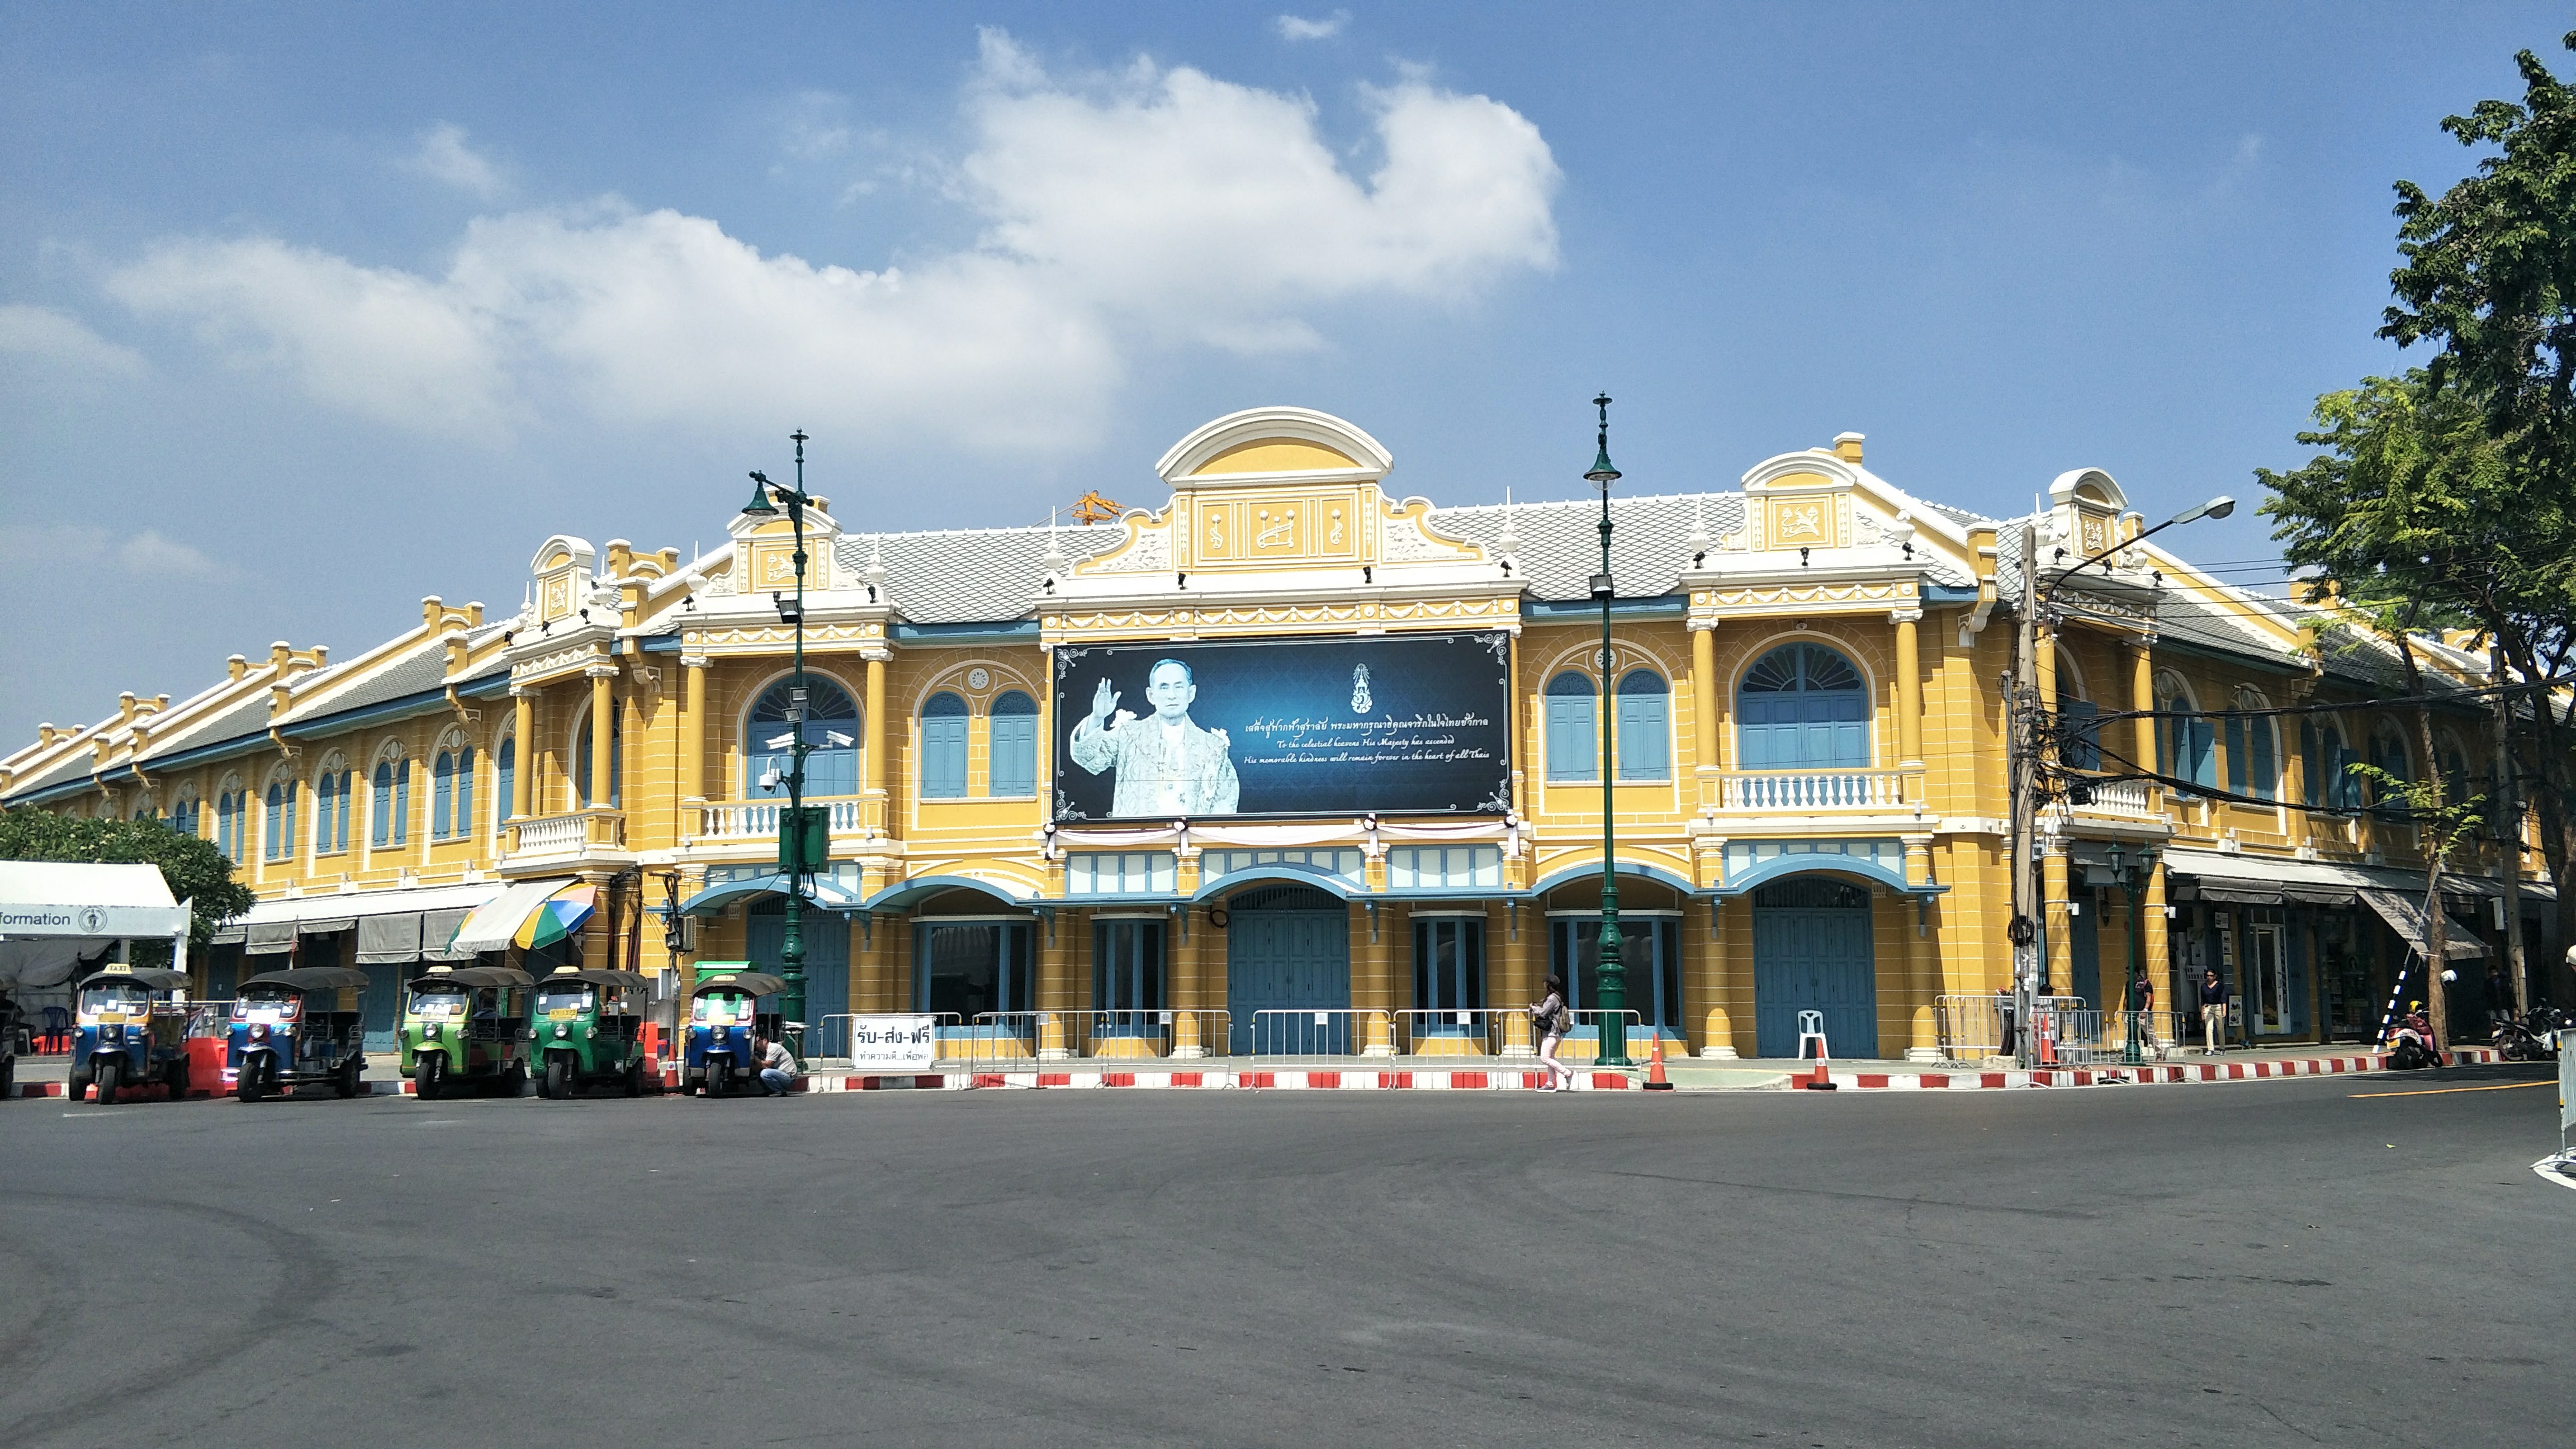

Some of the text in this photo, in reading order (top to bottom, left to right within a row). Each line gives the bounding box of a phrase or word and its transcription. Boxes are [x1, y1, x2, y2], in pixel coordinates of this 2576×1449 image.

[1245, 712, 1489, 738] เสด็จสู่ฟากฟ้าสุราลัย พระมหากรุณาธิคุณจารึกในใจไทยชั่วกาล
[1289, 738, 1300, 748] the
[1301, 737, 1333, 747] celestial
[1333, 736, 1360, 747] heavens
[1377, 737, 1409, 750] Majesty
[1411, 735, 1423, 745] has
[1425, 734, 1455, 745] ascended
[1244, 755, 1257, 764] His
[1259, 752, 1298, 763] memorable
[1298, 752, 1328, 763] kindness
[1329, 752, 1348, 762] will
[1370, 751, 1400, 764] forever
[1412, 750, 1423, 760] the
[1424, 749, 1444, 760] heart
[1445, 749, 1456, 763] of
[1455, 749, 1469, 759] all
[1469, 748, 1490, 759] Thais
[858, 1024, 930, 1044] รับ-ส่ง-ฟรี
